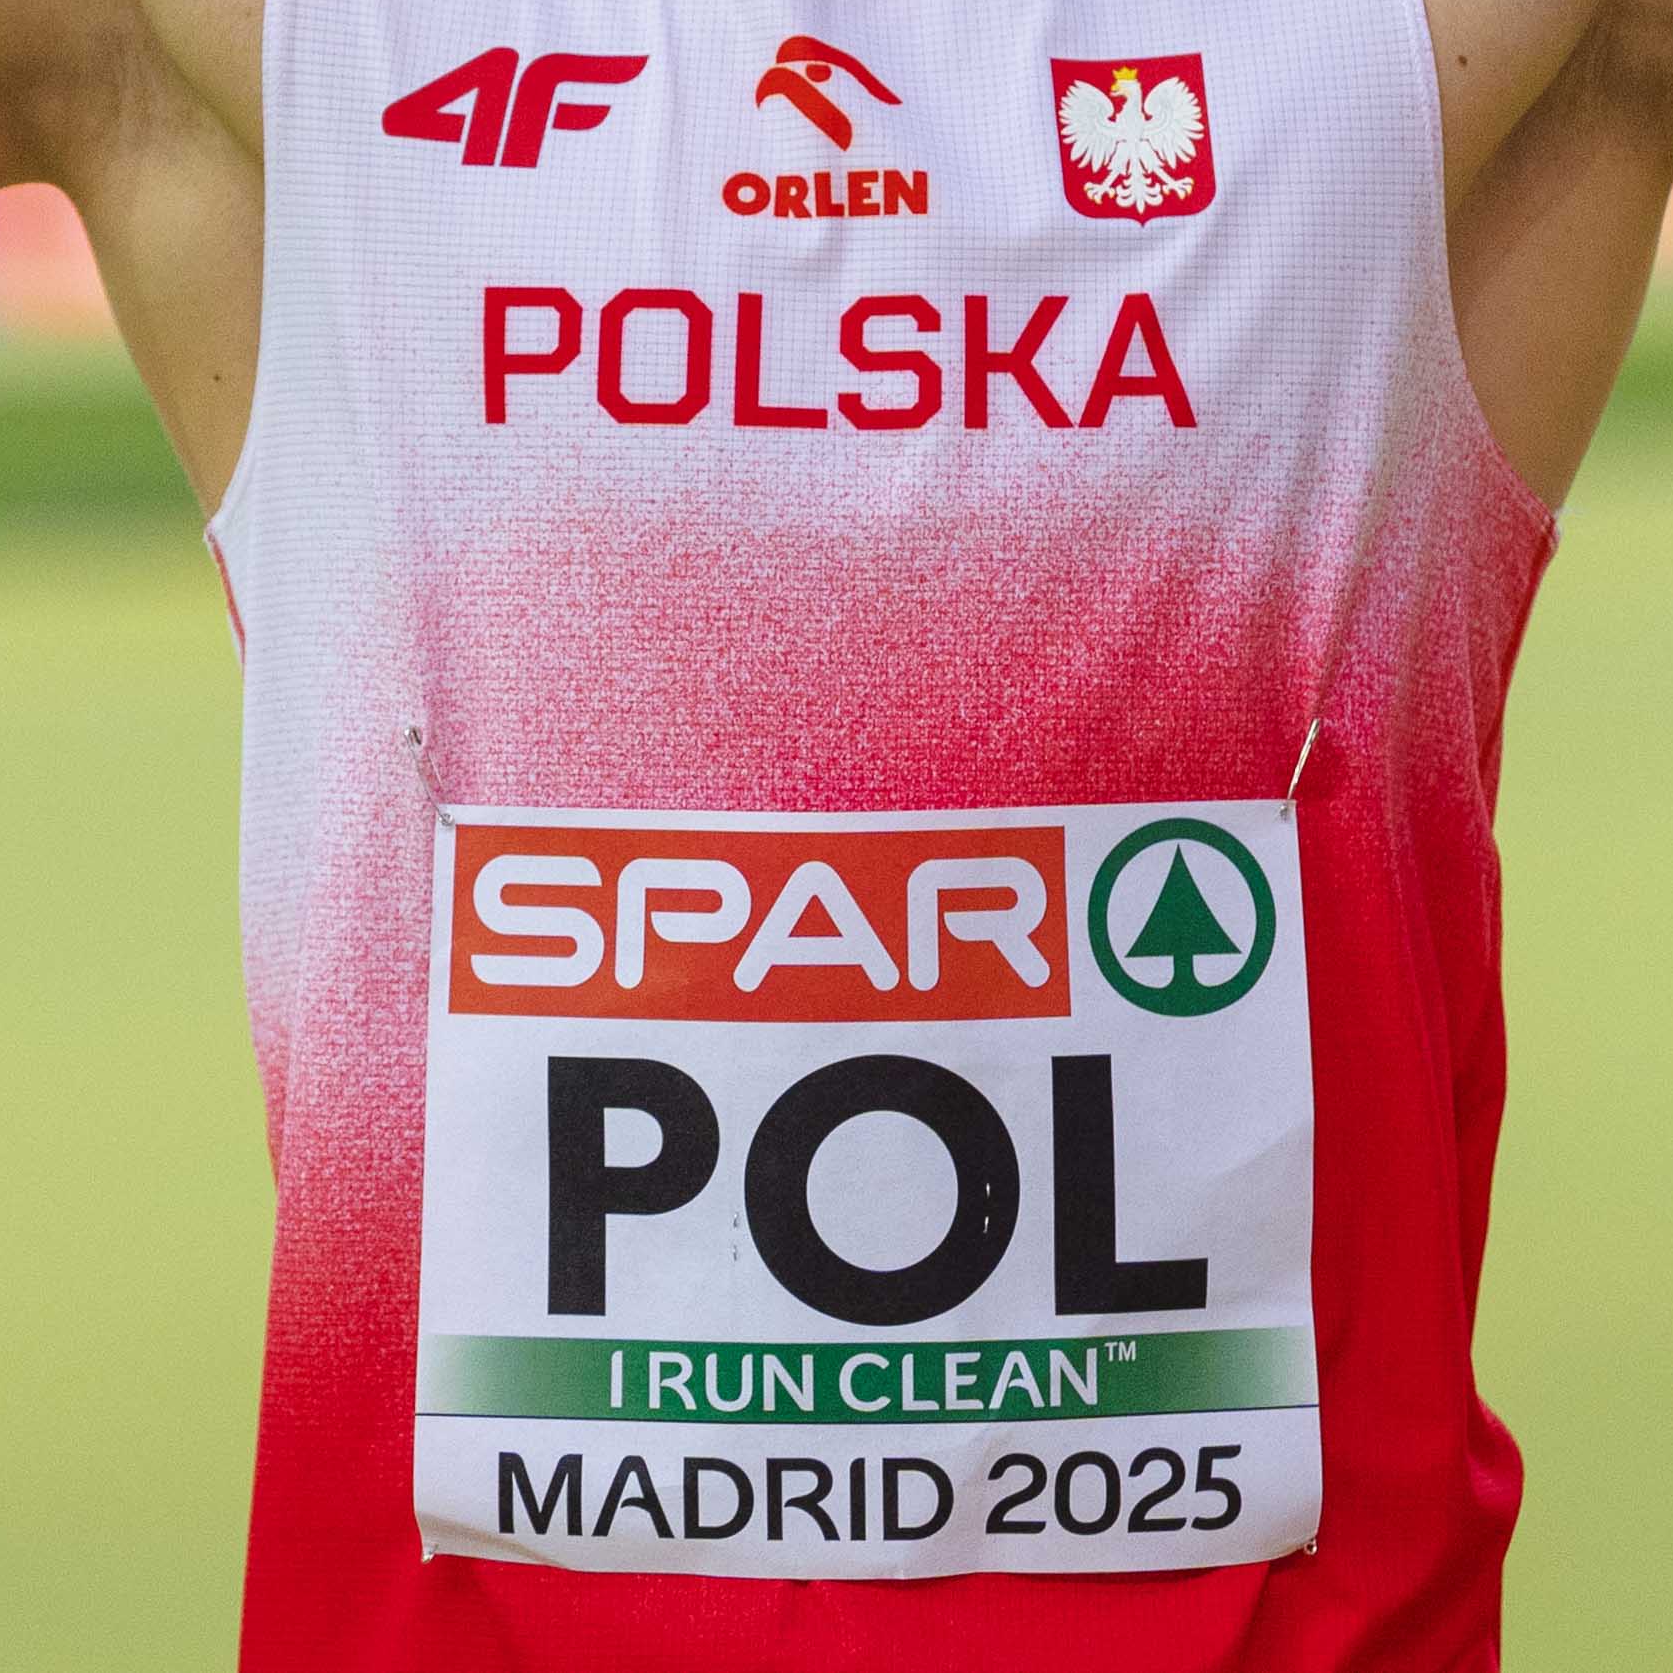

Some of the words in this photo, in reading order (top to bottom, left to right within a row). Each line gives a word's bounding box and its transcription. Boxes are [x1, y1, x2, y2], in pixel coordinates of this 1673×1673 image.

[380, 46, 650, 169] 4F
[721, 170, 929, 219] ORLEN
[483, 286, 1198, 430] POLSKA
[469, 853, 1050, 992] SPAR
[546, 1052, 1209, 1326] POL
[609, 1350, 624, 1409] I
[648, 1351, 815, 1413] RUN
[496, 1450, 954, 1543] MADRID
[984, 1443, 1243, 1536] 2025
